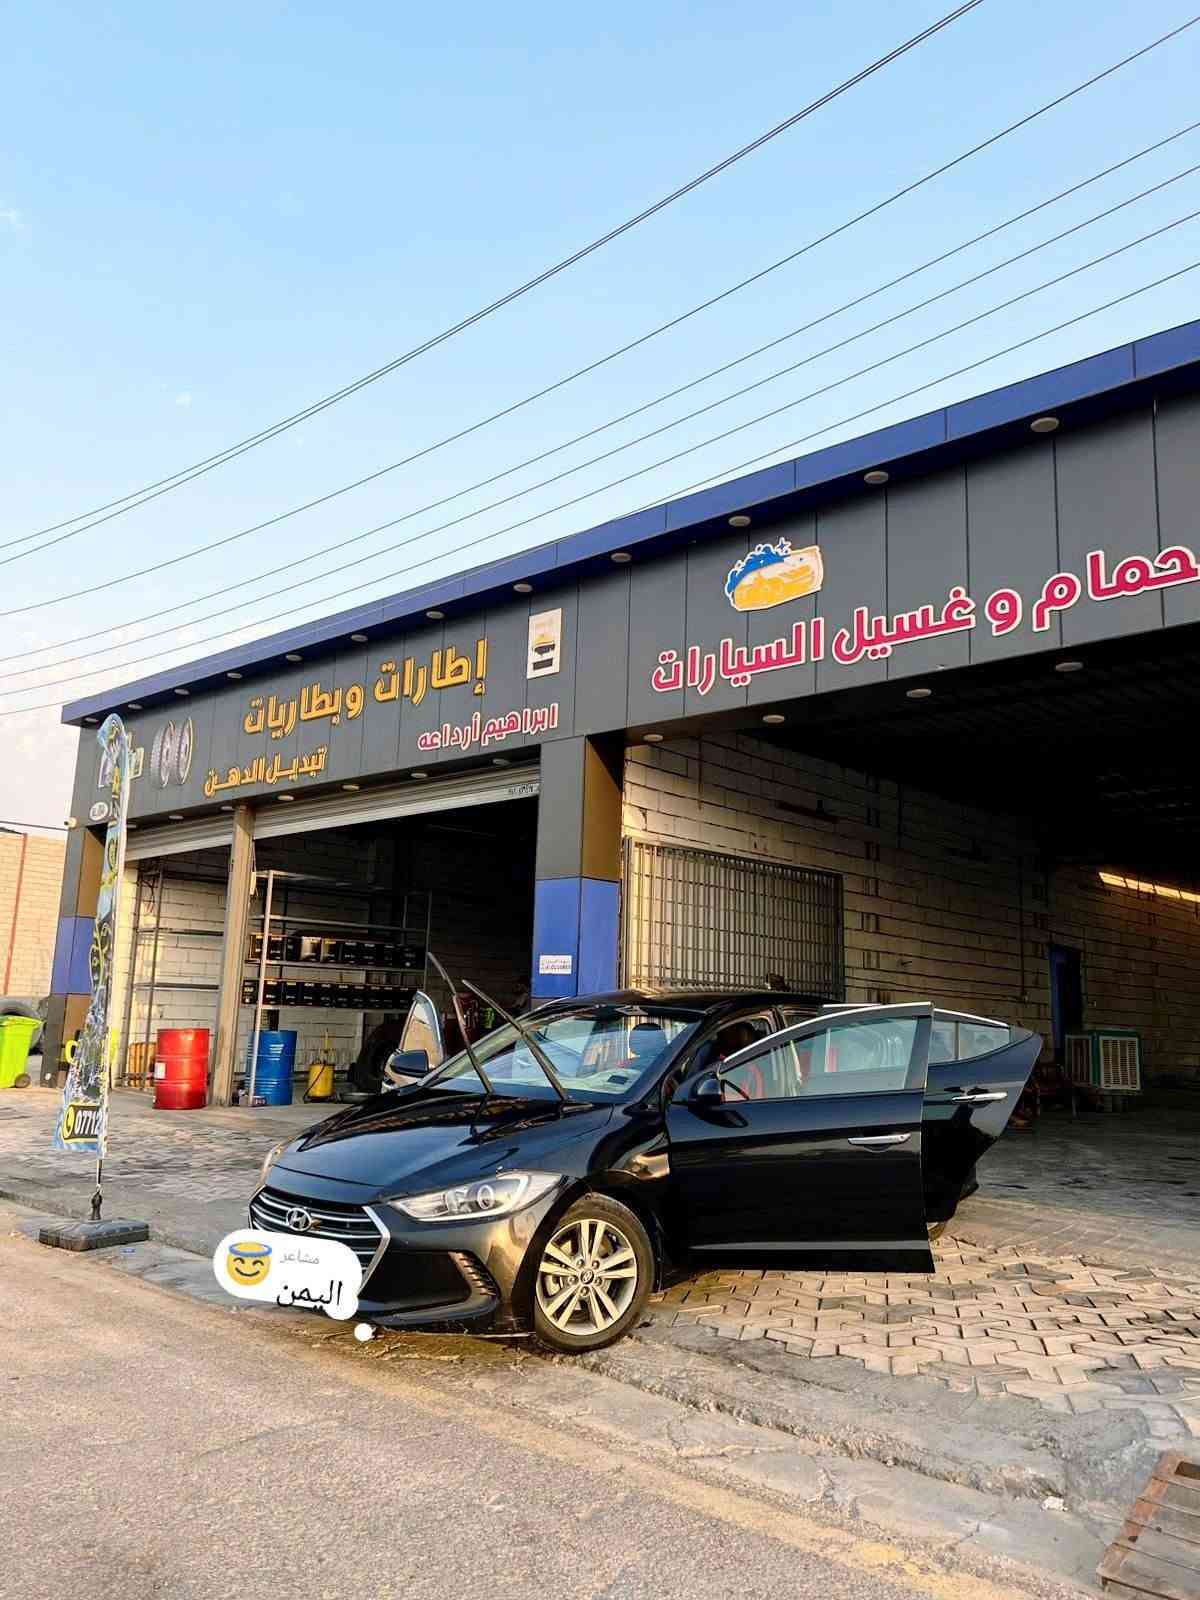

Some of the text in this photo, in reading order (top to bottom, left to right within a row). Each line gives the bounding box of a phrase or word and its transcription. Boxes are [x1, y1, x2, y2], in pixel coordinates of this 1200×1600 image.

[1031, 545, 1200, 632] حمام
[374, 637, 488, 705] إطارات
[652, 617, 825, 695] السيارات
[481, 702, 559, 746] ابراهيم
[204, 745, 328, 797] تبديل الدهن
